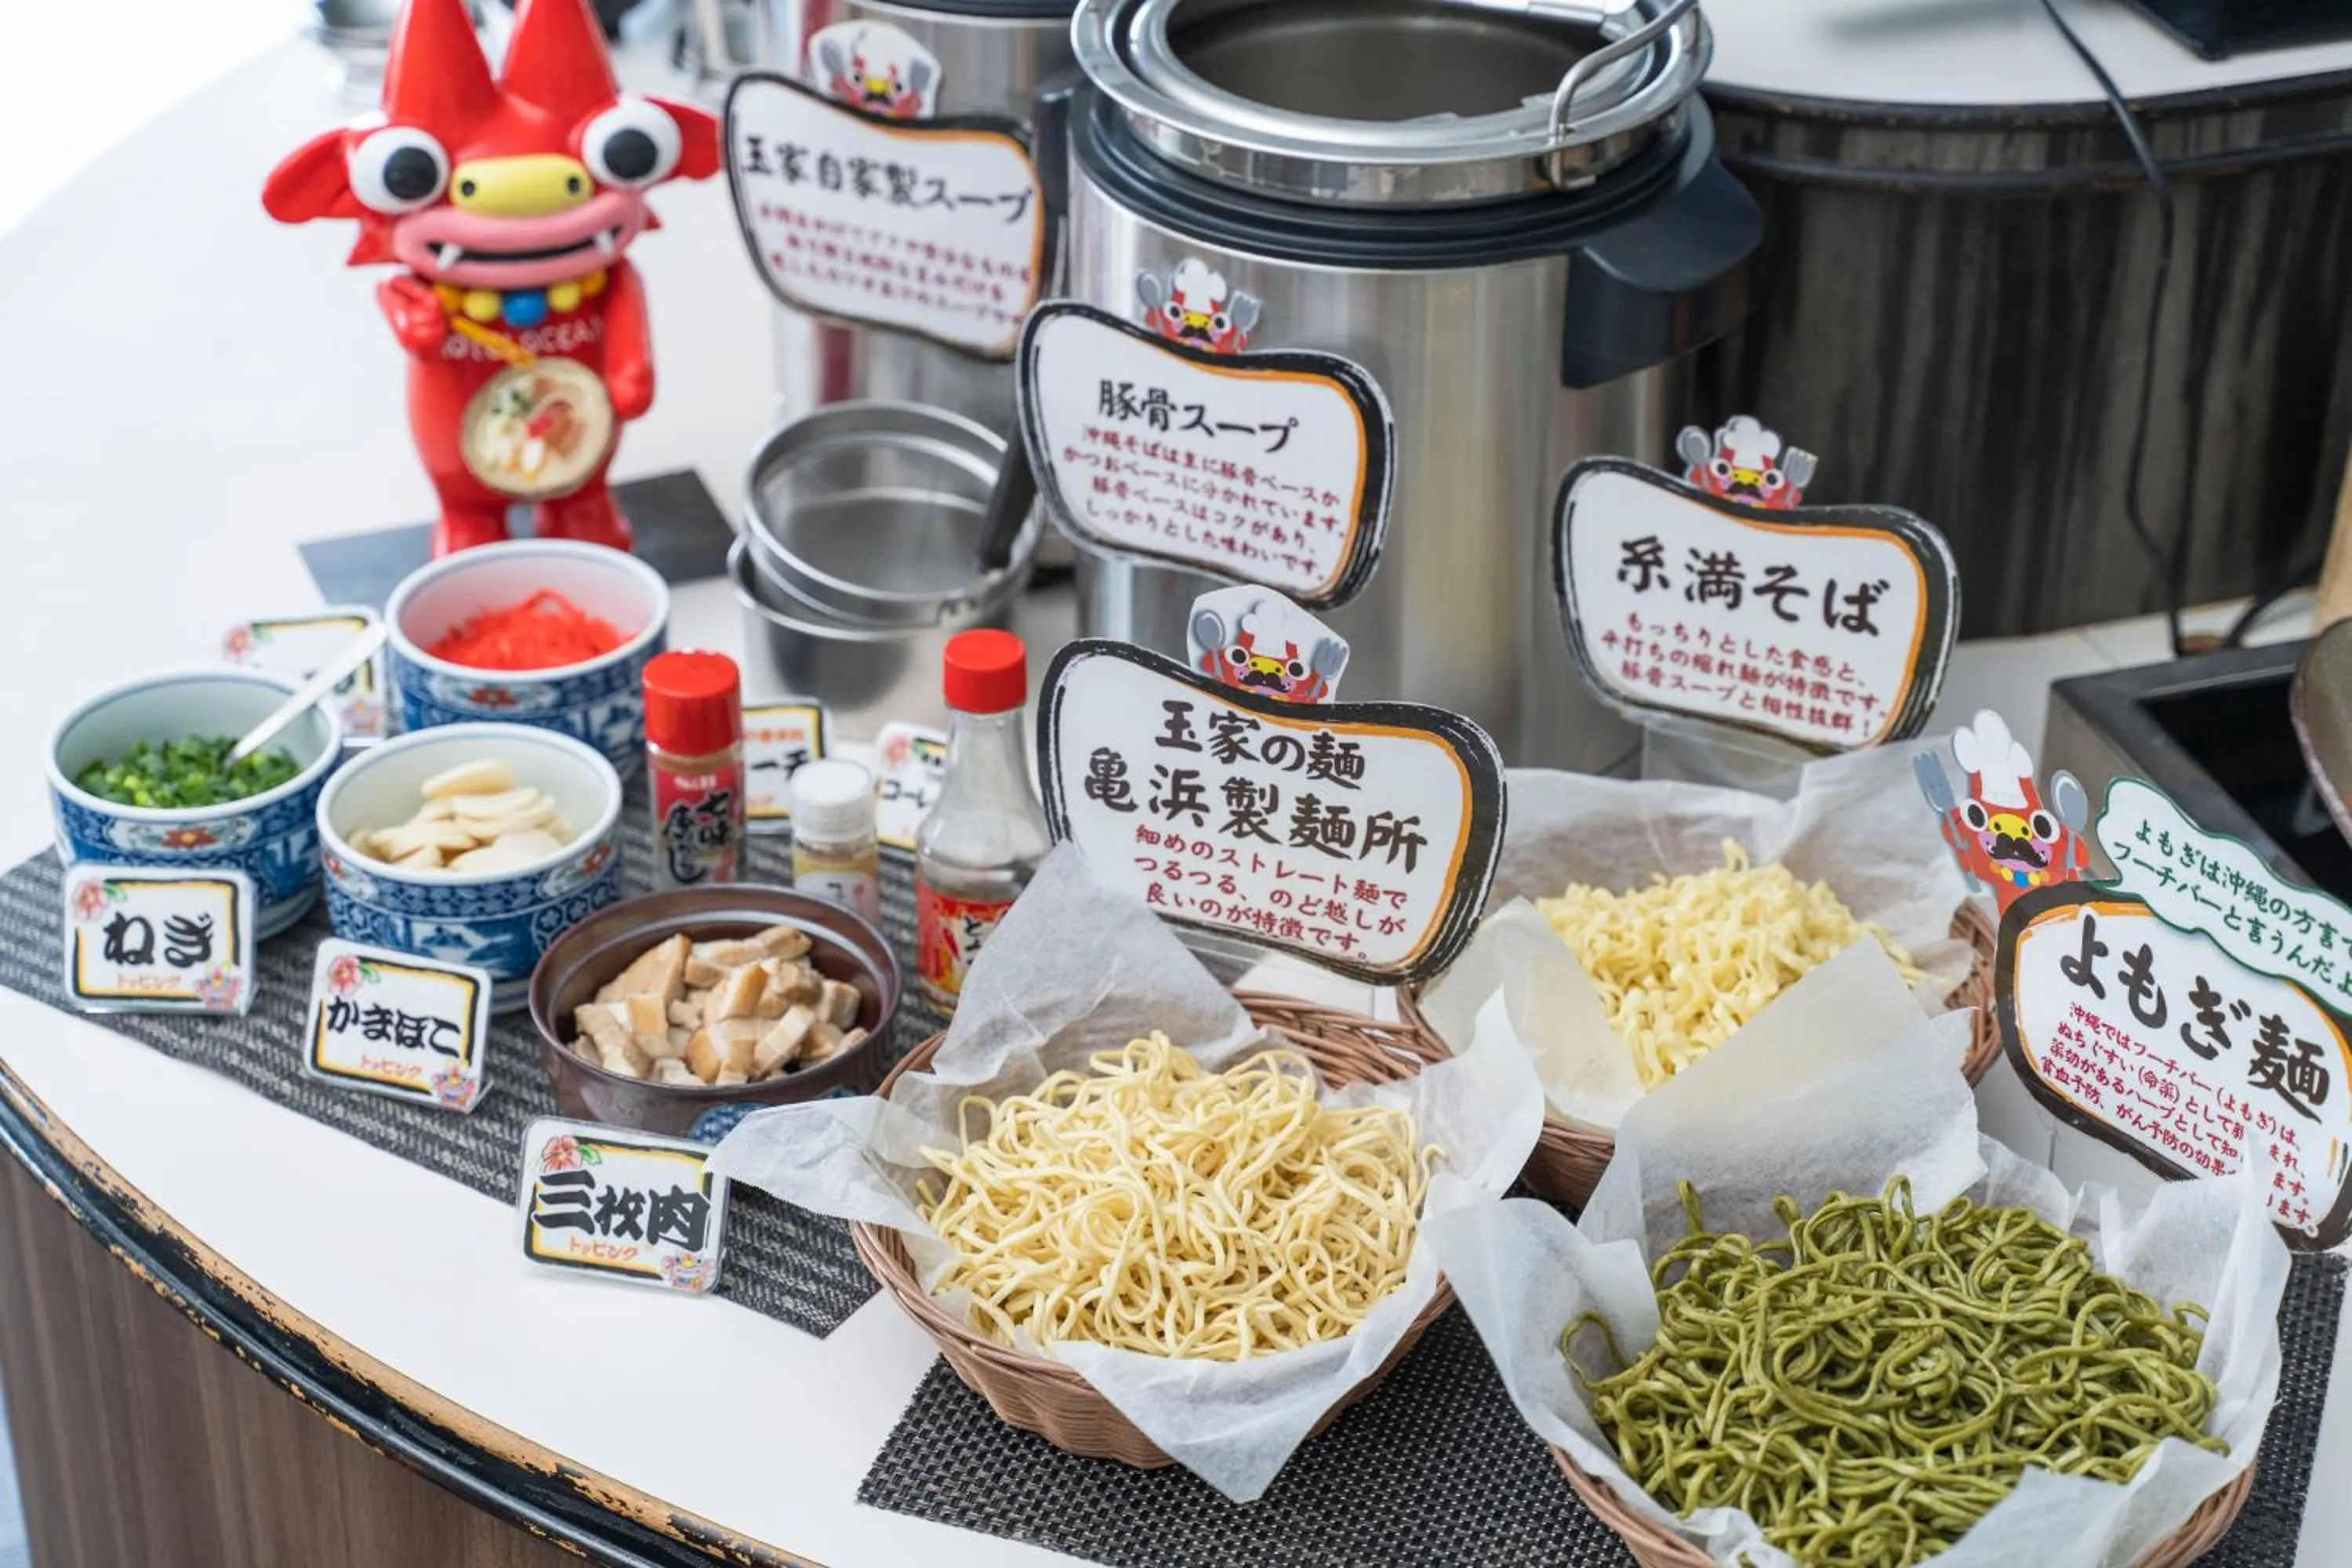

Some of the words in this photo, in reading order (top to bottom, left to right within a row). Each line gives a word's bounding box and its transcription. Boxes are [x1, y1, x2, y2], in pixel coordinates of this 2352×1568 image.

[1099, 379, 1298, 452] 豚骨スープ
[1063, 447, 1344, 538] かつおベースに分かれています。
[1087, 499, 1323, 581] しっかりとした味わいです。
[1617, 535, 1889, 637] 糸満そば
[1628, 612, 1865, 687] もっちりとした食感と、
[1154, 700, 1364, 789] 玉家の麺
[1084, 746, 1427, 874] 亀浜製麺所
[1134, 823, 1407, 909] 細めのストレート麺で
[103, 911, 214, 967] ねぎ
[1146, 882, 1367, 960] 良いのが特徴です。
[327, 996, 462, 1058] かまぼこ
[2060, 914, 2329, 1124] よもぎ麺
[532, 1170, 710, 1252] 三枚肉
